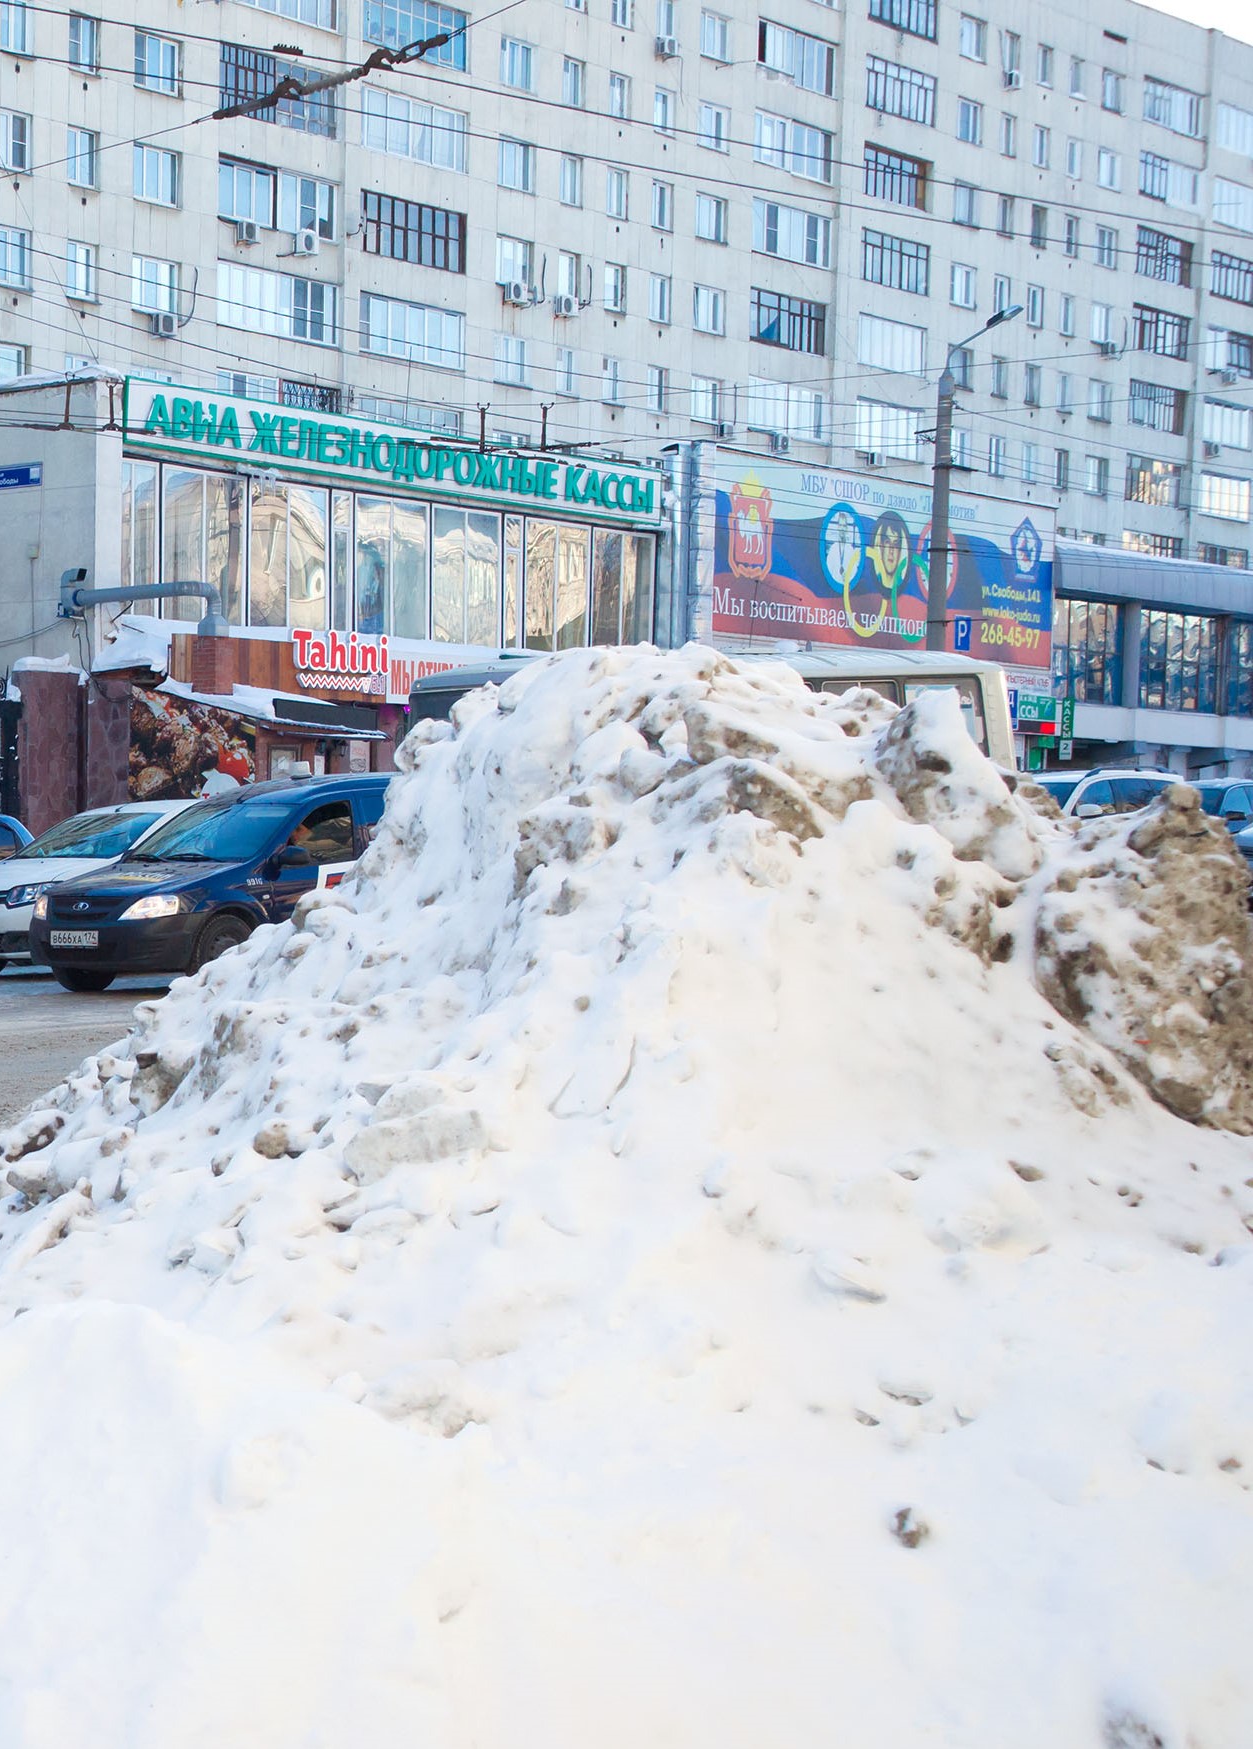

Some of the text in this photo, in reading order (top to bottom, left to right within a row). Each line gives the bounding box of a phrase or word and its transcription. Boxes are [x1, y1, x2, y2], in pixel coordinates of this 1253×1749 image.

[144, 394, 654, 514] АВИА ЖЕЛЕЗНОДОРОЖНЫЕ КАССЫ
[800, 473, 828, 495] МБУ
[872, 491, 885, 504] по
[886, 494, 917, 510] дзюдо
[713, 586, 927, 637] Мы воспитываем чемпион
[293, 630, 389, 673] Tahini
[981, 622, 1041, 649] 268-45-97
[391, 660, 415, 695] МЫ
[1062, 700, 1071, 738] КАССЫ
[53, 932, 96, 944] В666ХА 174
